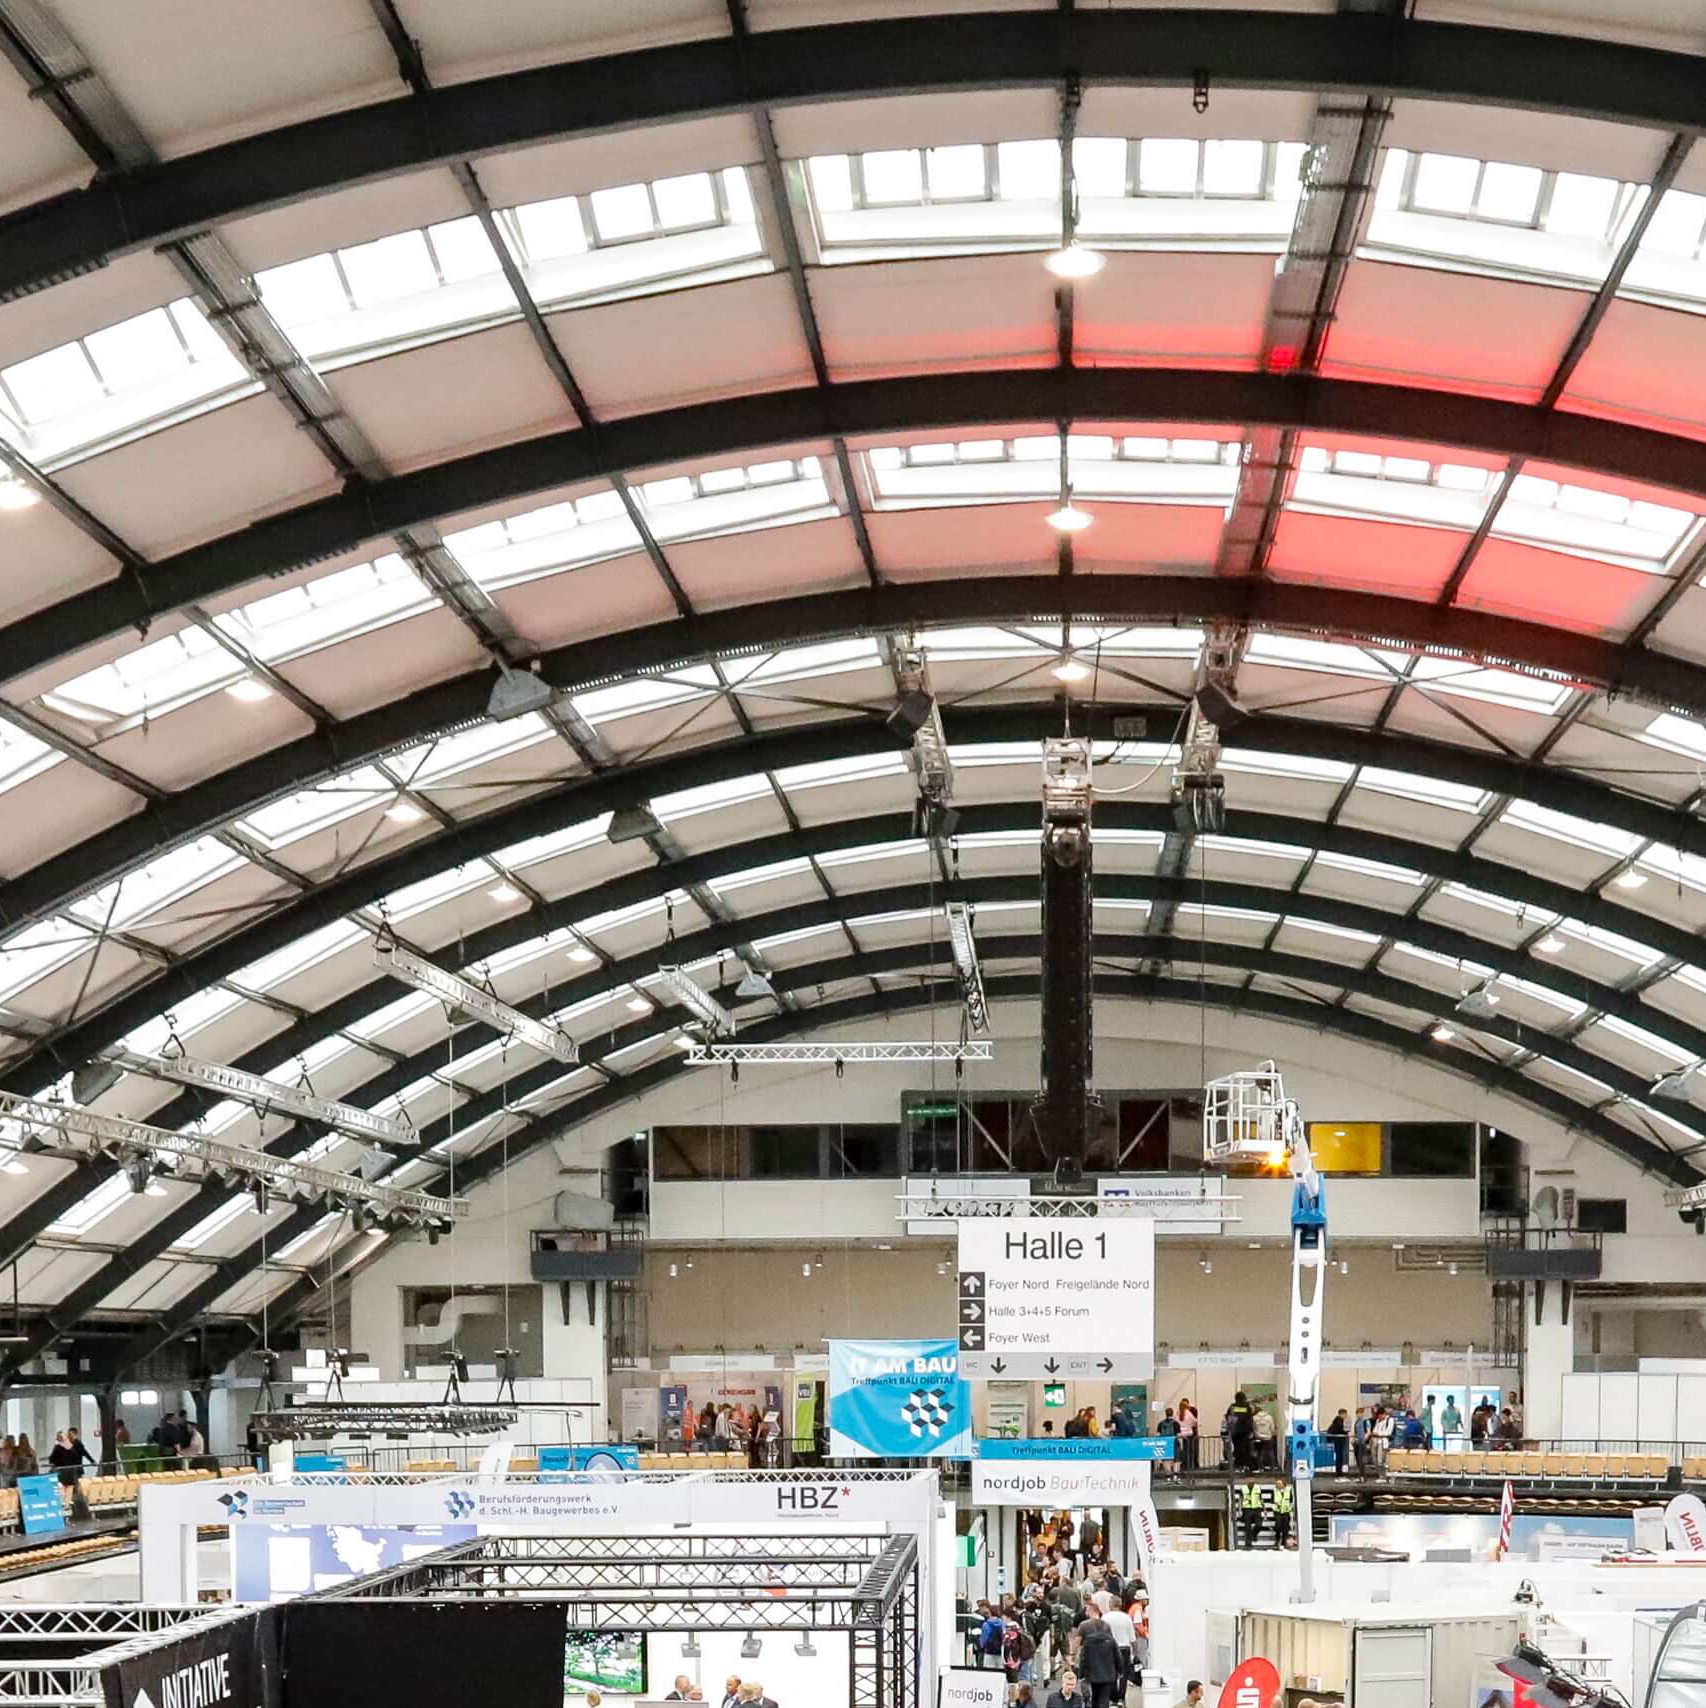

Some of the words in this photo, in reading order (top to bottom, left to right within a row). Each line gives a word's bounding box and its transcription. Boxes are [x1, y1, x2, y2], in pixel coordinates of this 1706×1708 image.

[1005, 1231, 1084, 1260] Halle
[1094, 1231, 1107, 1260] 1
[988, 1279, 1019, 1292] Foyer
[1022, 1279, 1050, 1290] Nord
[1055, 1279, 1120, 1292] Freigelände
[1122, 1279, 1150, 1290] Nord
[988, 1306, 1016, 1317] Halle
[1018, 1306, 1052, 1317] 3+4+5
[1054, 1306, 1090, 1317] Forum
[988, 1332, 1019, 1346] Foyer
[1022, 1332, 1051, 1343] West
[873, 1356, 909, 1374] AM
[912, 1356, 957, 1374] BAU
[965, 1361, 979, 1370] WC
[1070, 1361, 1087, 1370] EXIT
[983, 1475, 1046, 1493] nordjob
[947, 1687, 994, 1703] nordjob
